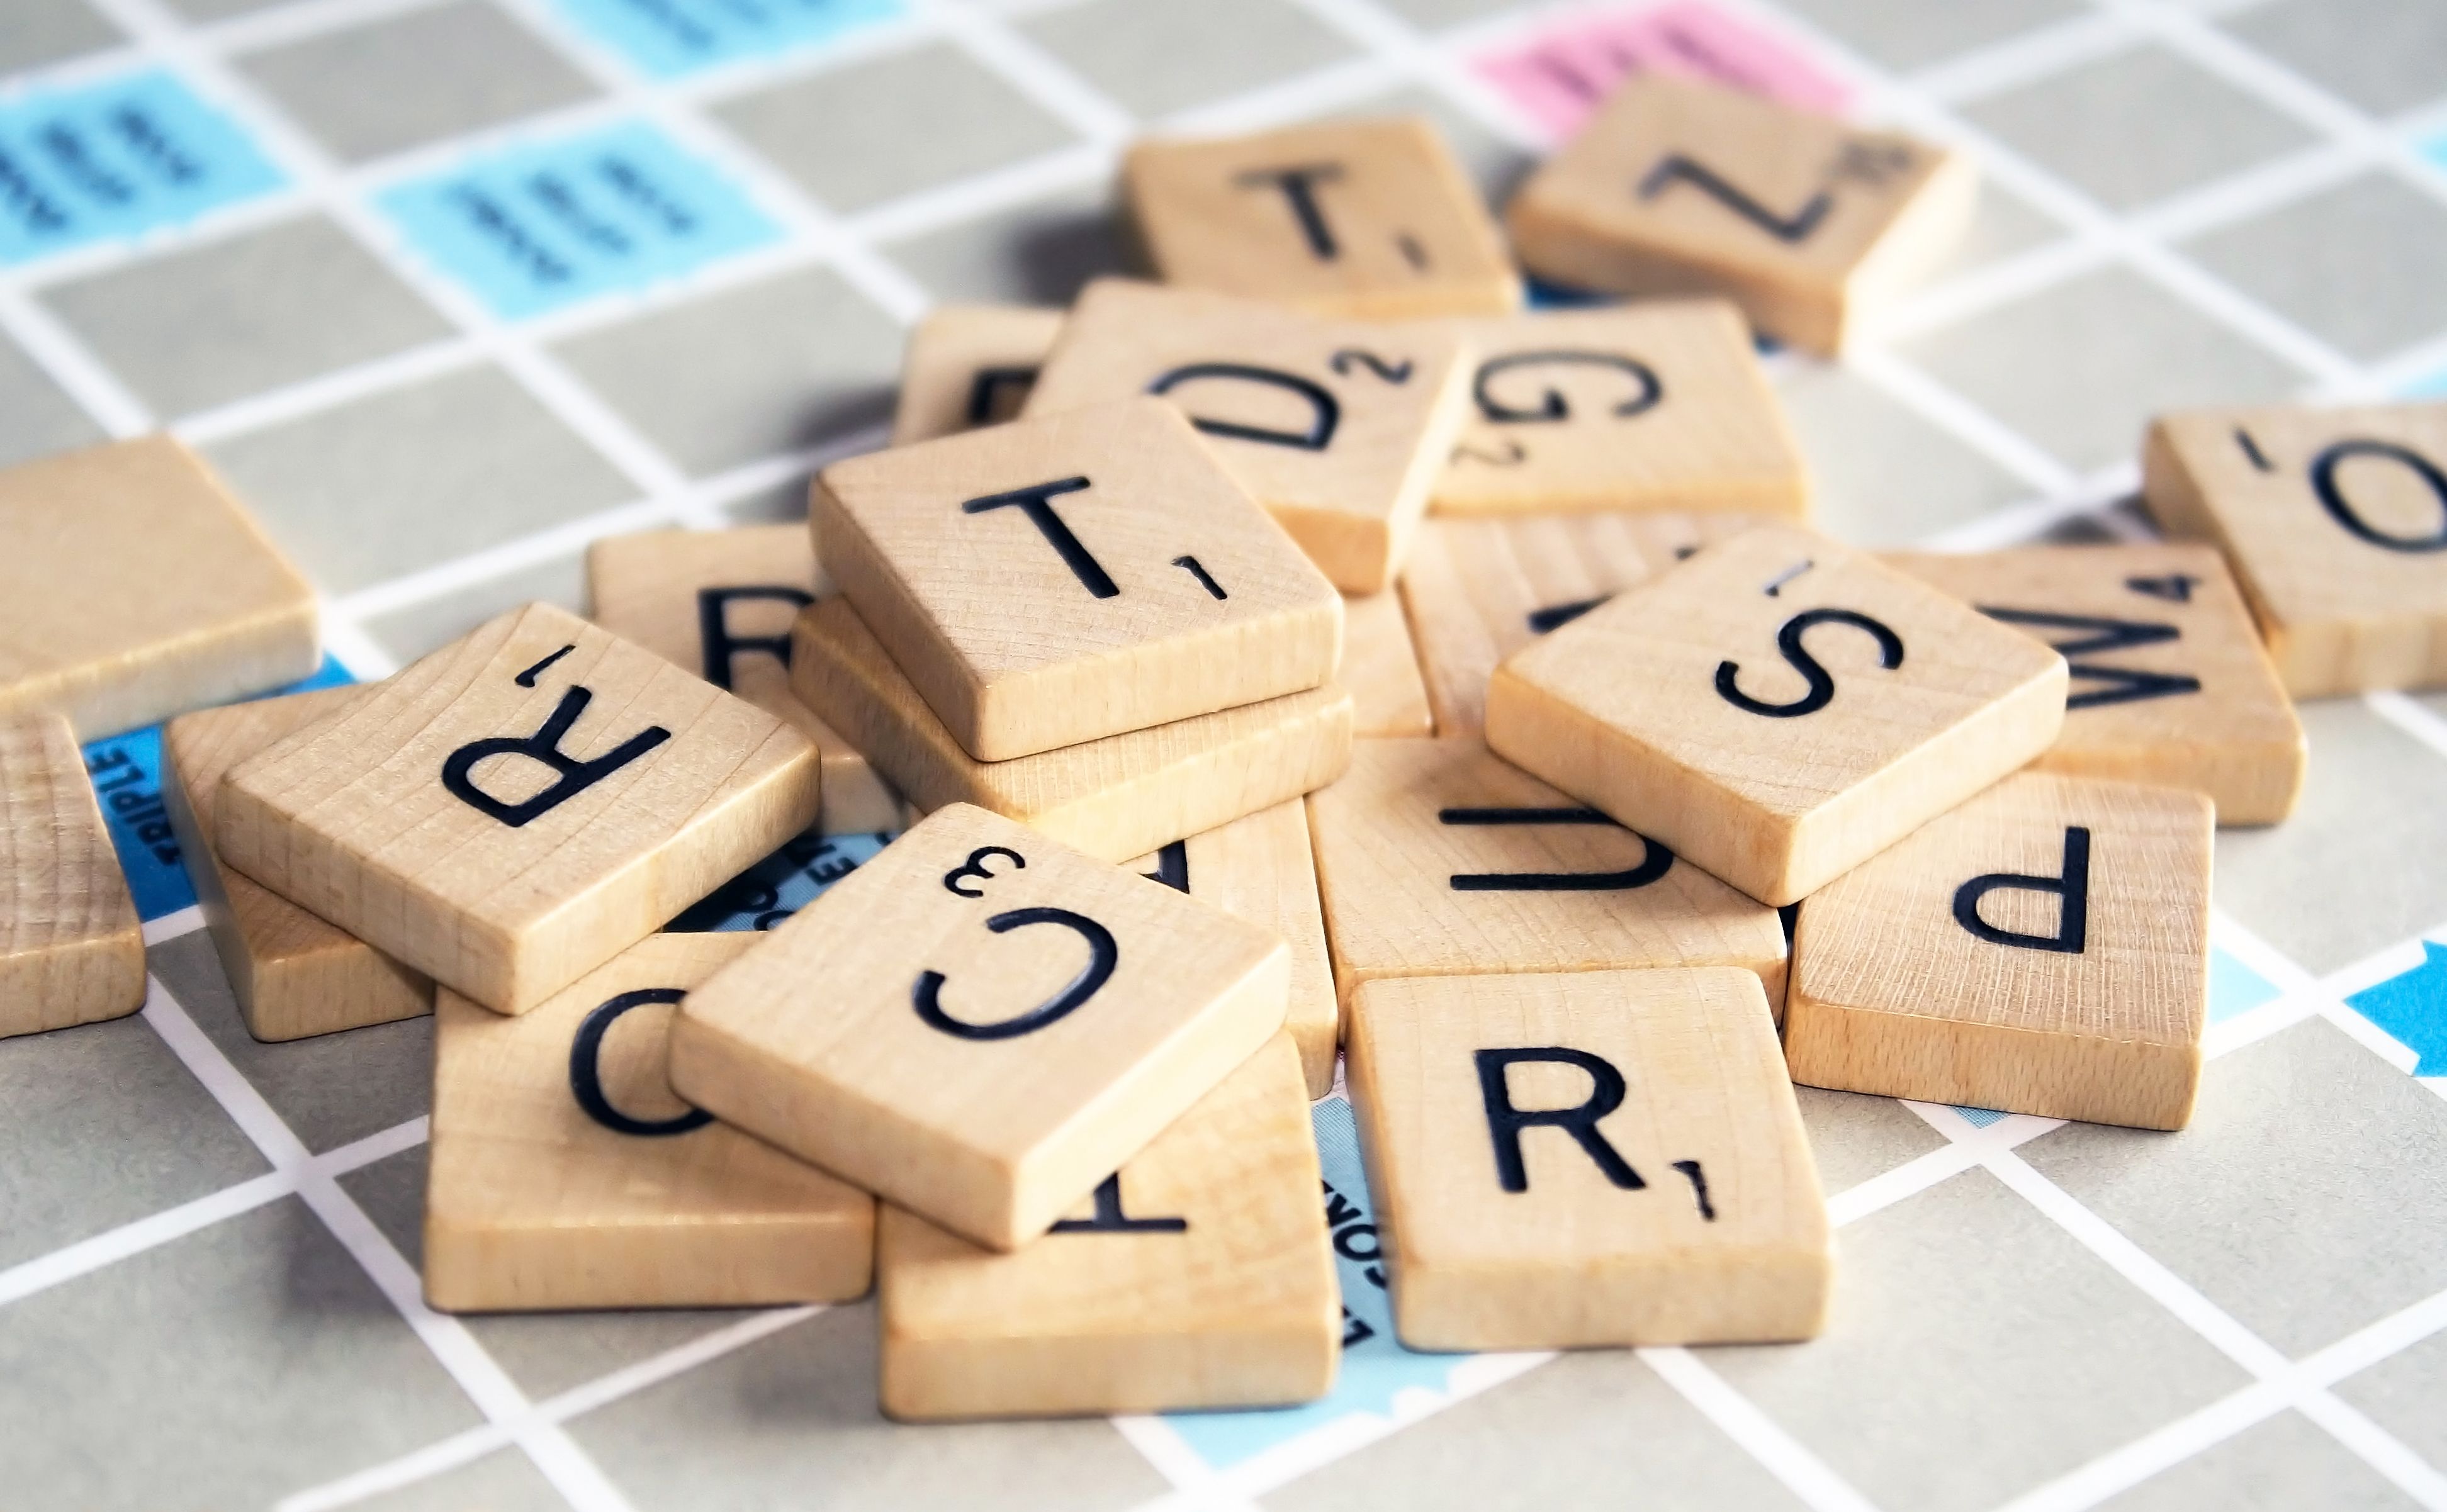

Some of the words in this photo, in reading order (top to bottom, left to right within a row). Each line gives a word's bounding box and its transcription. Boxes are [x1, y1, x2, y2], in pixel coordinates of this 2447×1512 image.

[1229, 162, 1346, 261] T
[1638, 153, 1834, 244] Z
[1147, 363, 1341, 451] D
[1331, 350, 1413, 385] 2
[1473, 349, 1663, 423] G
[962, 475, 1122, 600] T
[1171, 555, 1229, 601] 1
[2309, 439, 2447, 554] O
[2126, 574, 2201, 602] 4
[514, 644, 577, 688] 1
[1714, 608, 1904, 719] S
[442, 685, 672, 828] R
[943, 846, 1027, 898] 3
[1438, 807, 1674, 892] U
[1952, 826, 2091, 955] P
[913, 907, 1118, 1041] C
[1475, 1046, 1648, 1194] R
[1671, 1160, 1716, 1221] 1
